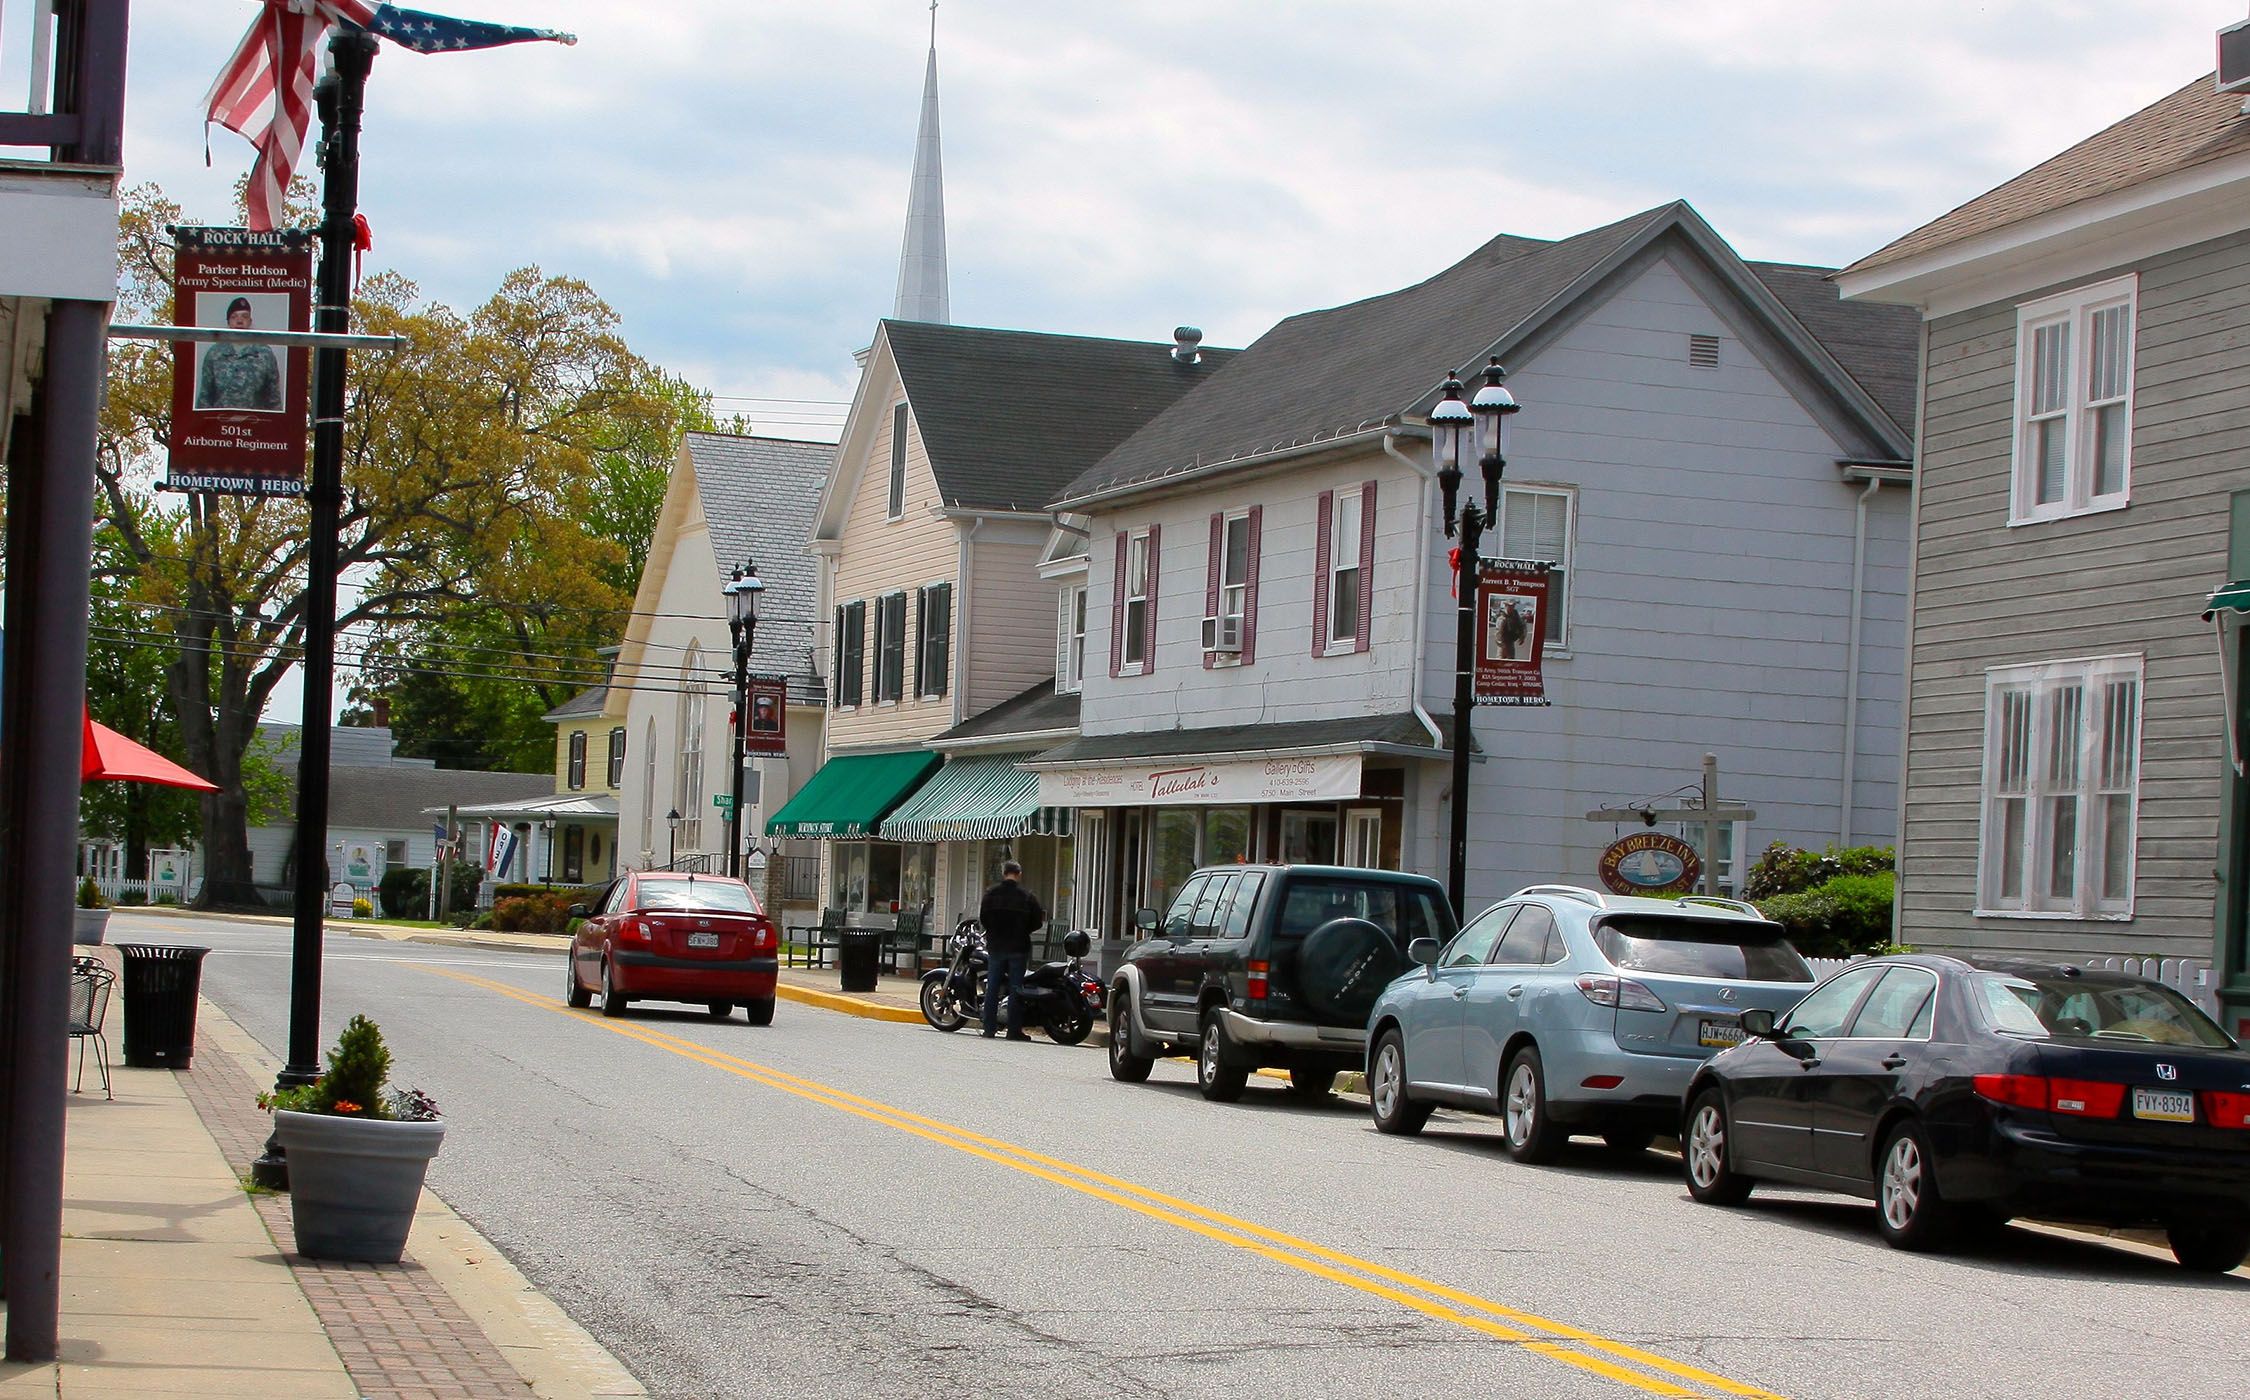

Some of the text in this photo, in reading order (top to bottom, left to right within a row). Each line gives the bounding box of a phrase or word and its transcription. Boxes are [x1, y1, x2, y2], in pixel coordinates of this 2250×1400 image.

[203, 231, 284, 246] ROCK HALL
[198, 263, 288, 276] Parker Hudson
[178, 276, 307, 289] Army Specialist (Medic)
[221, 425, 252, 436] 501st
[184, 436, 289, 451] Airborne Regiment
[169, 475, 302, 492] HOMETOWN HERO
[1494, 560, 1535, 570] ROCK HALL
[1476, 695, 1544, 704] HOMETOWN HERO
[1264, 761, 1291, 778] Gallery
[1148, 766, 1219, 799] Tallulah's
[1298, 788, 1317, 797] Street
[1603, 836, 1697, 868] BAY BREEZE INN
